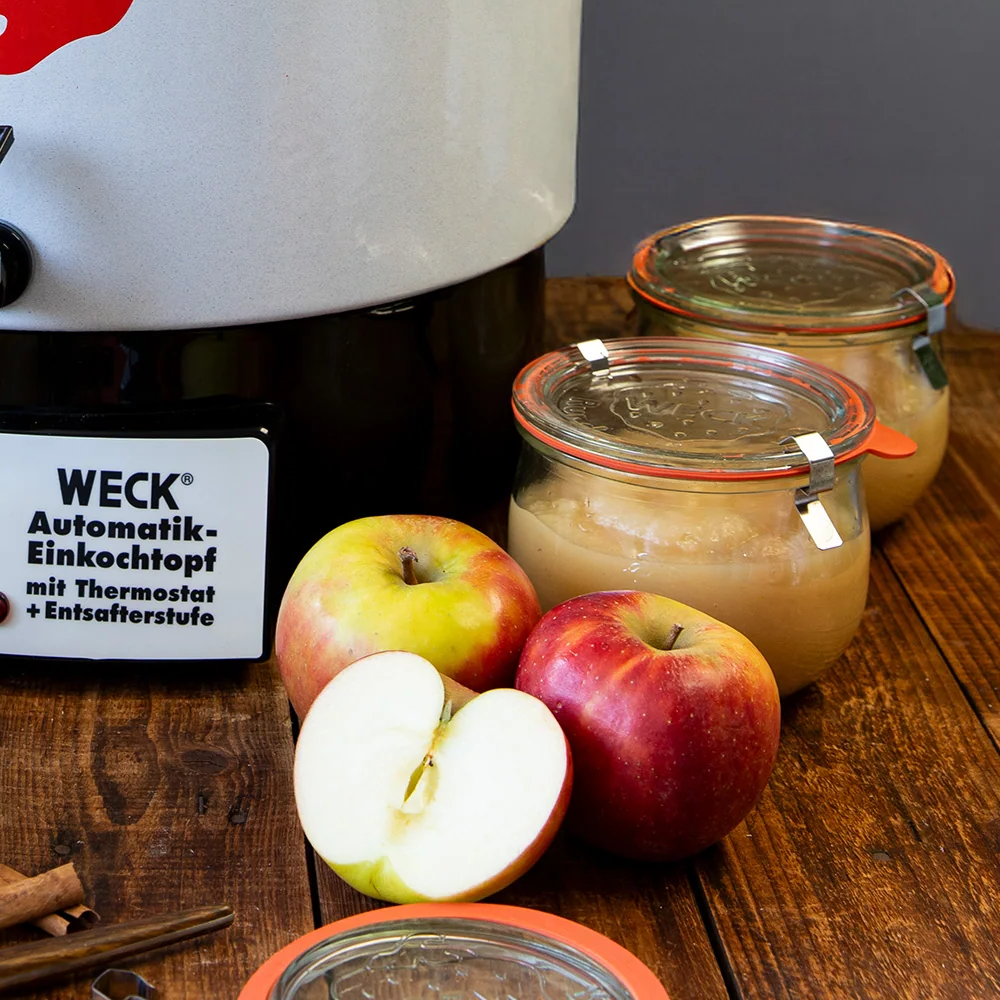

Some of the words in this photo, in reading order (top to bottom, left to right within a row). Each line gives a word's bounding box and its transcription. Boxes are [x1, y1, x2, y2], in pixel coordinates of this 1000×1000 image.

[27, 511, 218, 541] Automatik-
[27, 539, 218, 578] Einkochtopf
[26, 576, 67, 597] mit
[75, 578, 216, 603] Thermostat
